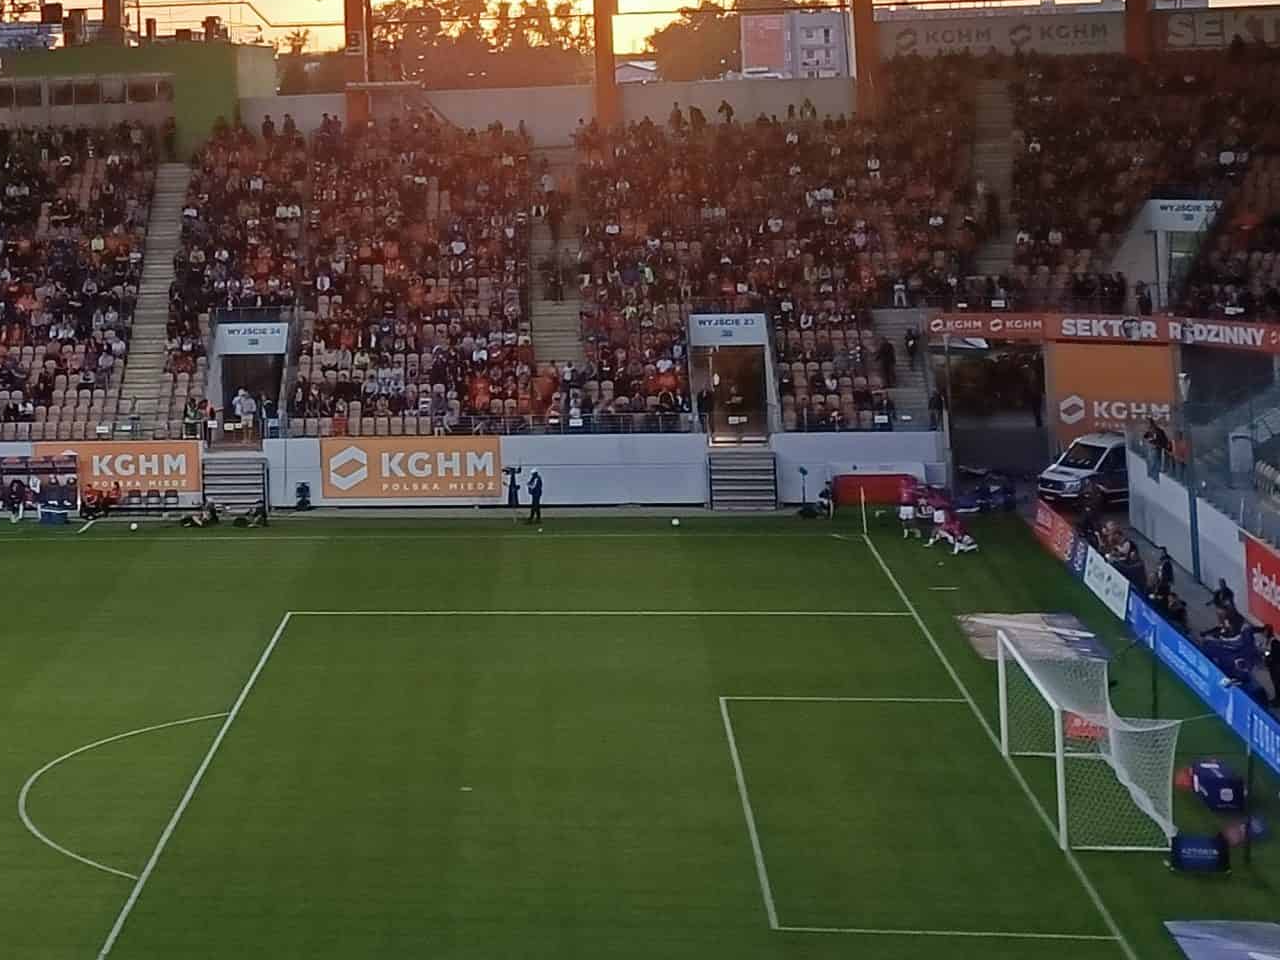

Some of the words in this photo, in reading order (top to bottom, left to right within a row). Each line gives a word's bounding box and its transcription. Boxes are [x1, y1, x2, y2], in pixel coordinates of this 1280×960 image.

[1039, 24, 1108, 41] KGHM
[946, 319, 983, 329] KGHM
[1006, 319, 1043, 329] KGHM
[1093, 400, 1170, 421] KGHM
[91, 453, 186, 476] KGHM
[380, 451, 494, 478] KGHM
[381, 483, 440, 492] POLSKA
